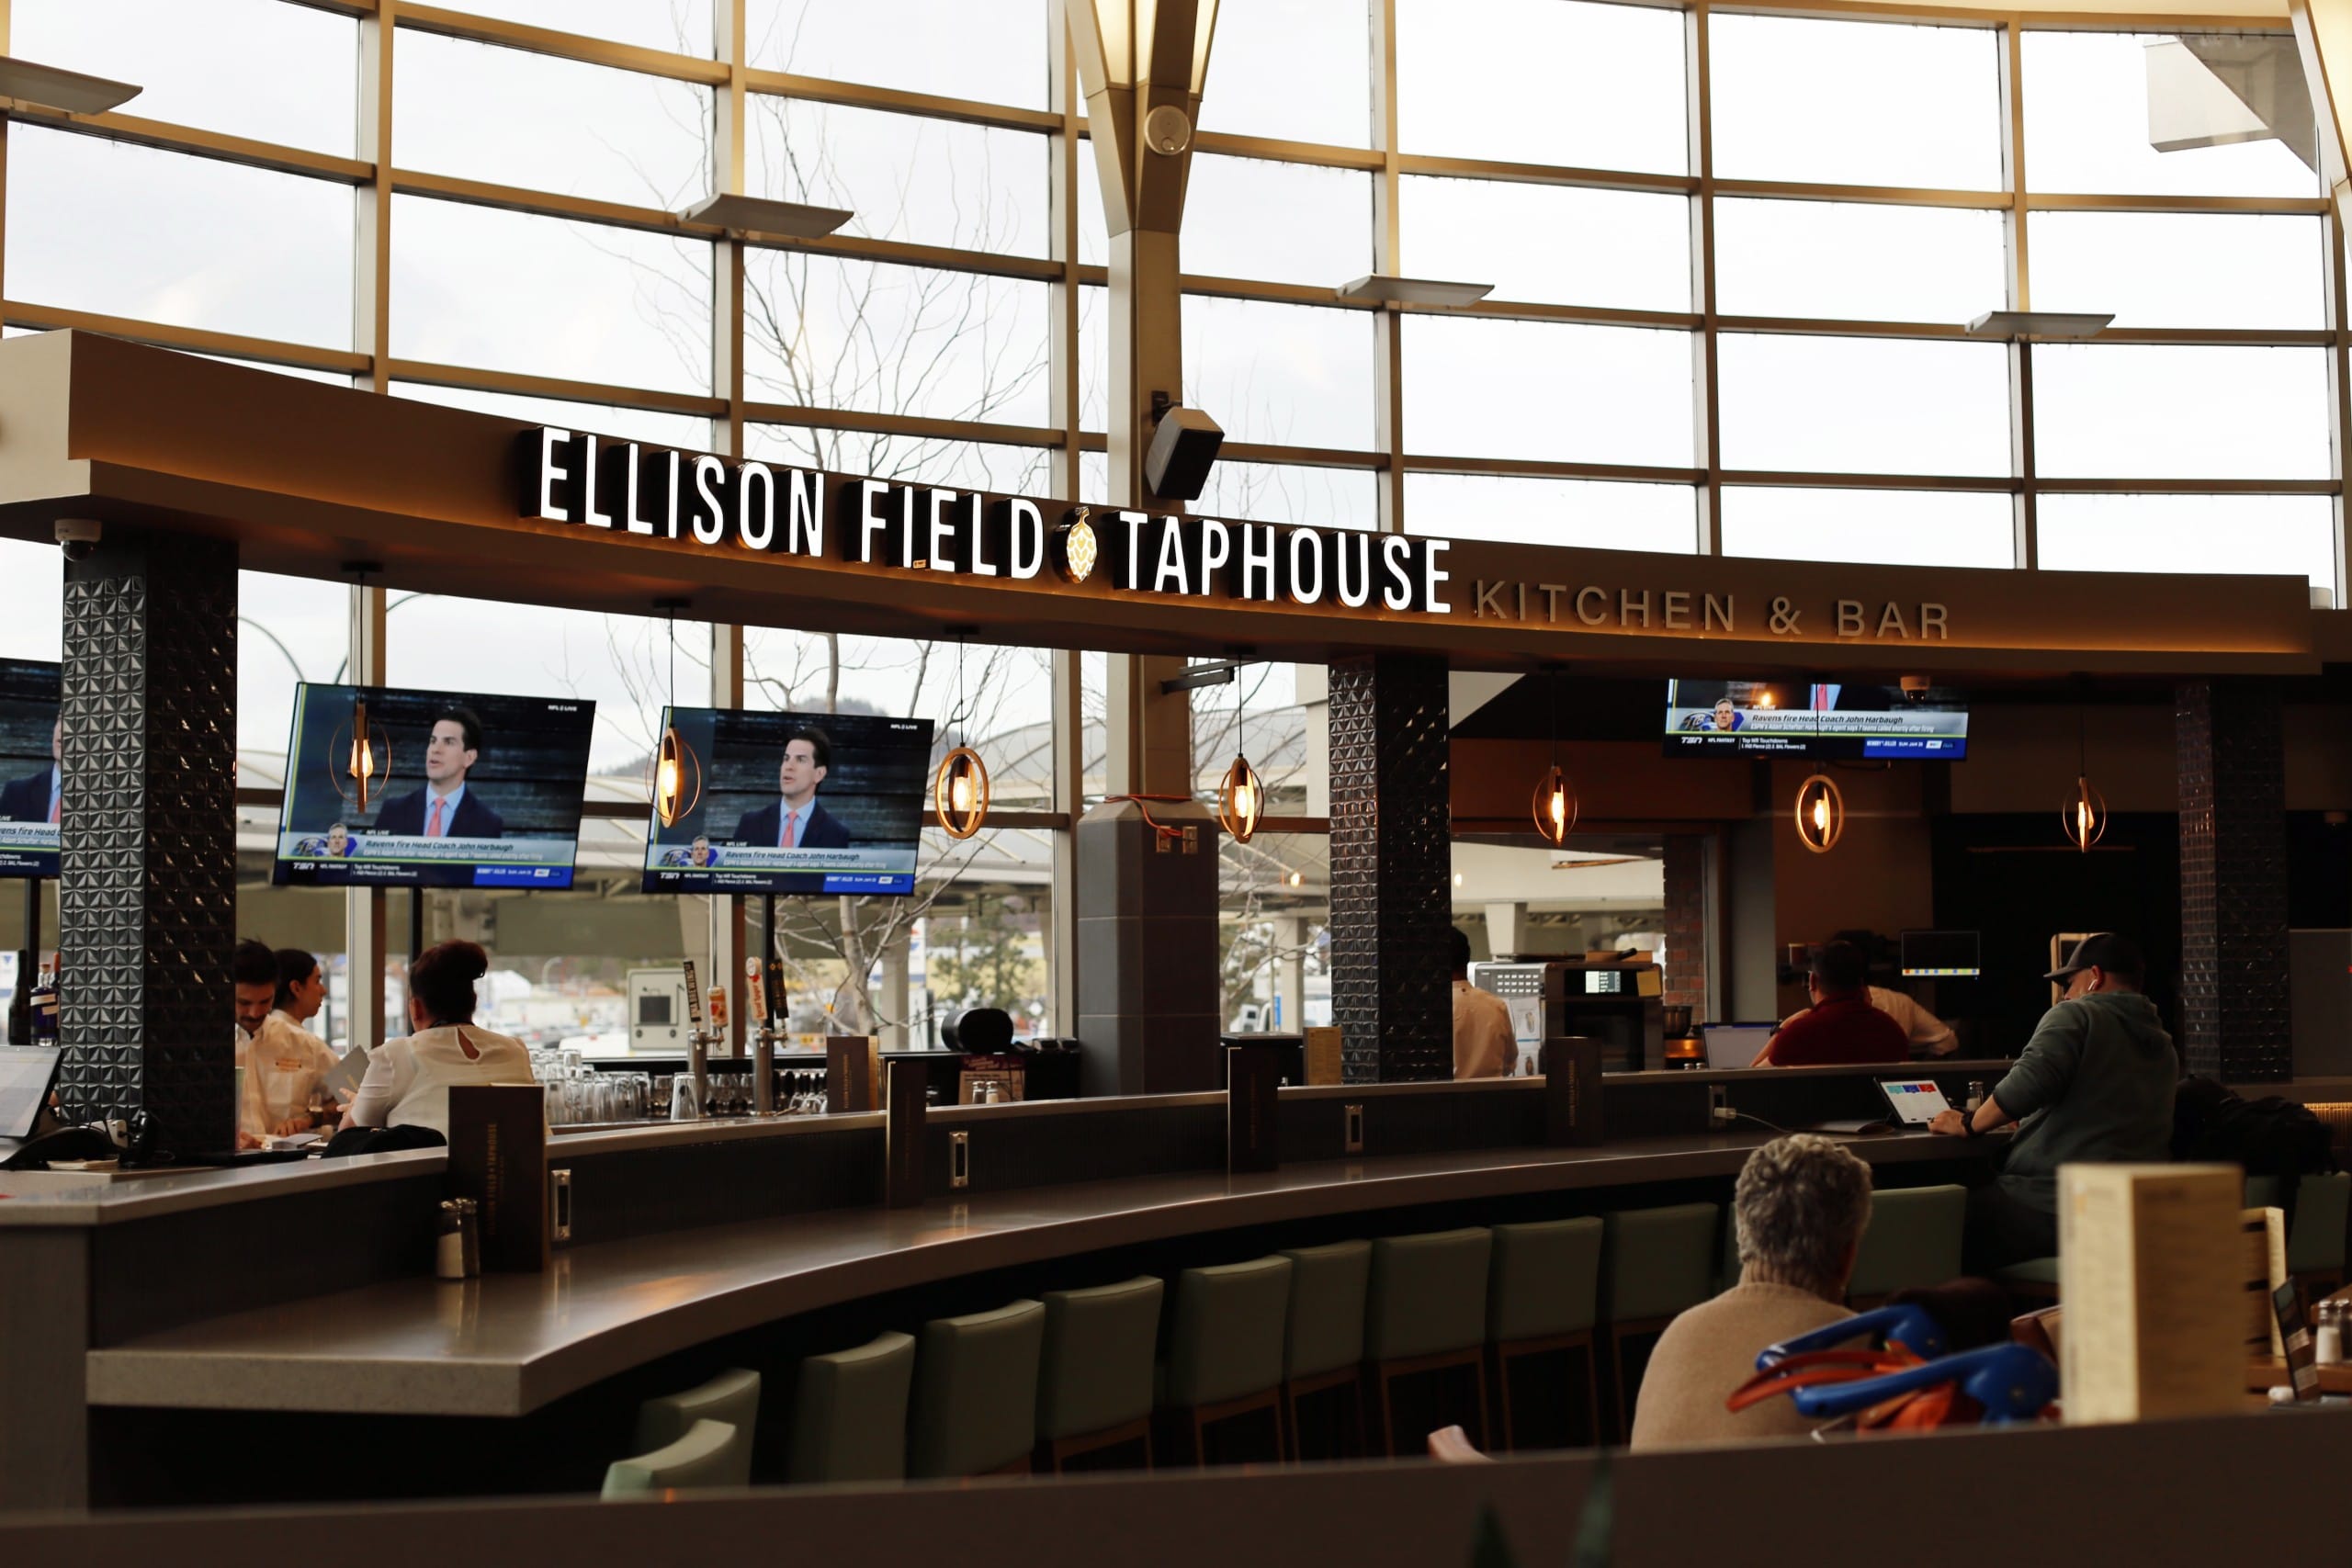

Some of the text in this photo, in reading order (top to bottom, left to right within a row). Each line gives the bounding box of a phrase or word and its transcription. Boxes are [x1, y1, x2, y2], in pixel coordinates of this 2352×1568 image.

[538, 425, 1452, 614] ELLISON FIELD TAPHOUSE
[1476, 580, 1949, 639] KITCHEN & BAR
[1782, 714, 1798, 722] fire
[1845, 716, 1864, 724] John
[1865, 716, 1904, 725] Harbaugh
[18, 827, 33, 835] fire
[34, 829, 56, 837] Head
[366, 840, 394, 848] Ravens
[396, 840, 410, 848] fire
[412, 840, 432, 849] Head
[433, 841, 456, 850] Coach
[477, 843, 514, 852] Harbaugh
[726, 851, 752, 859] Ravens
[753, 851, 765, 859] fire
[827, 853, 860, 862] Harbaugh
